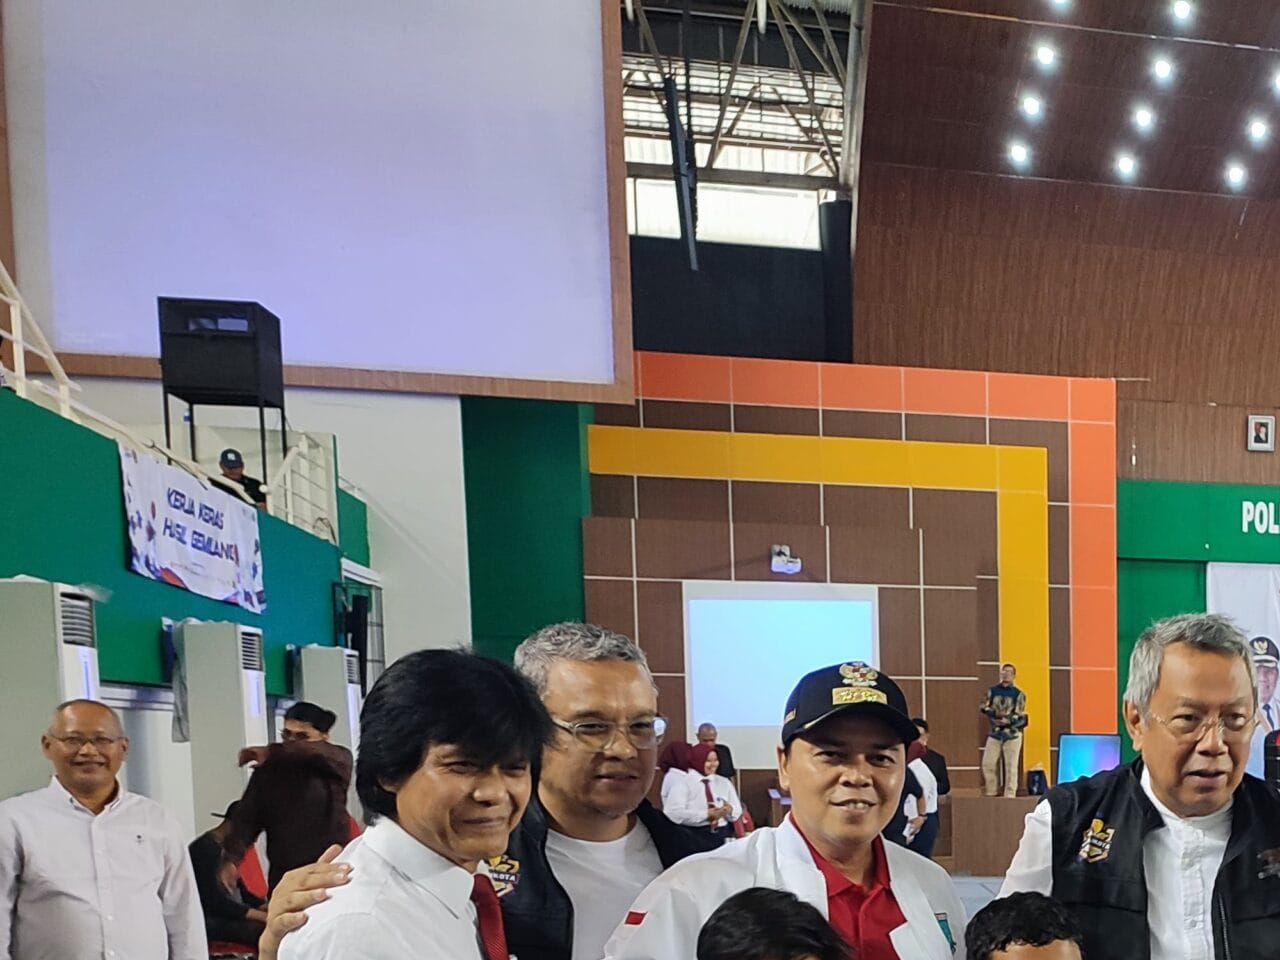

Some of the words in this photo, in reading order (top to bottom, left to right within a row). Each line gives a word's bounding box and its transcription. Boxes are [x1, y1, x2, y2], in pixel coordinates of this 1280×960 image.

[166, 487, 195, 518] KERJA
[198, 502, 224, 530] KERAS
[162, 517, 187, 545] HASIL
